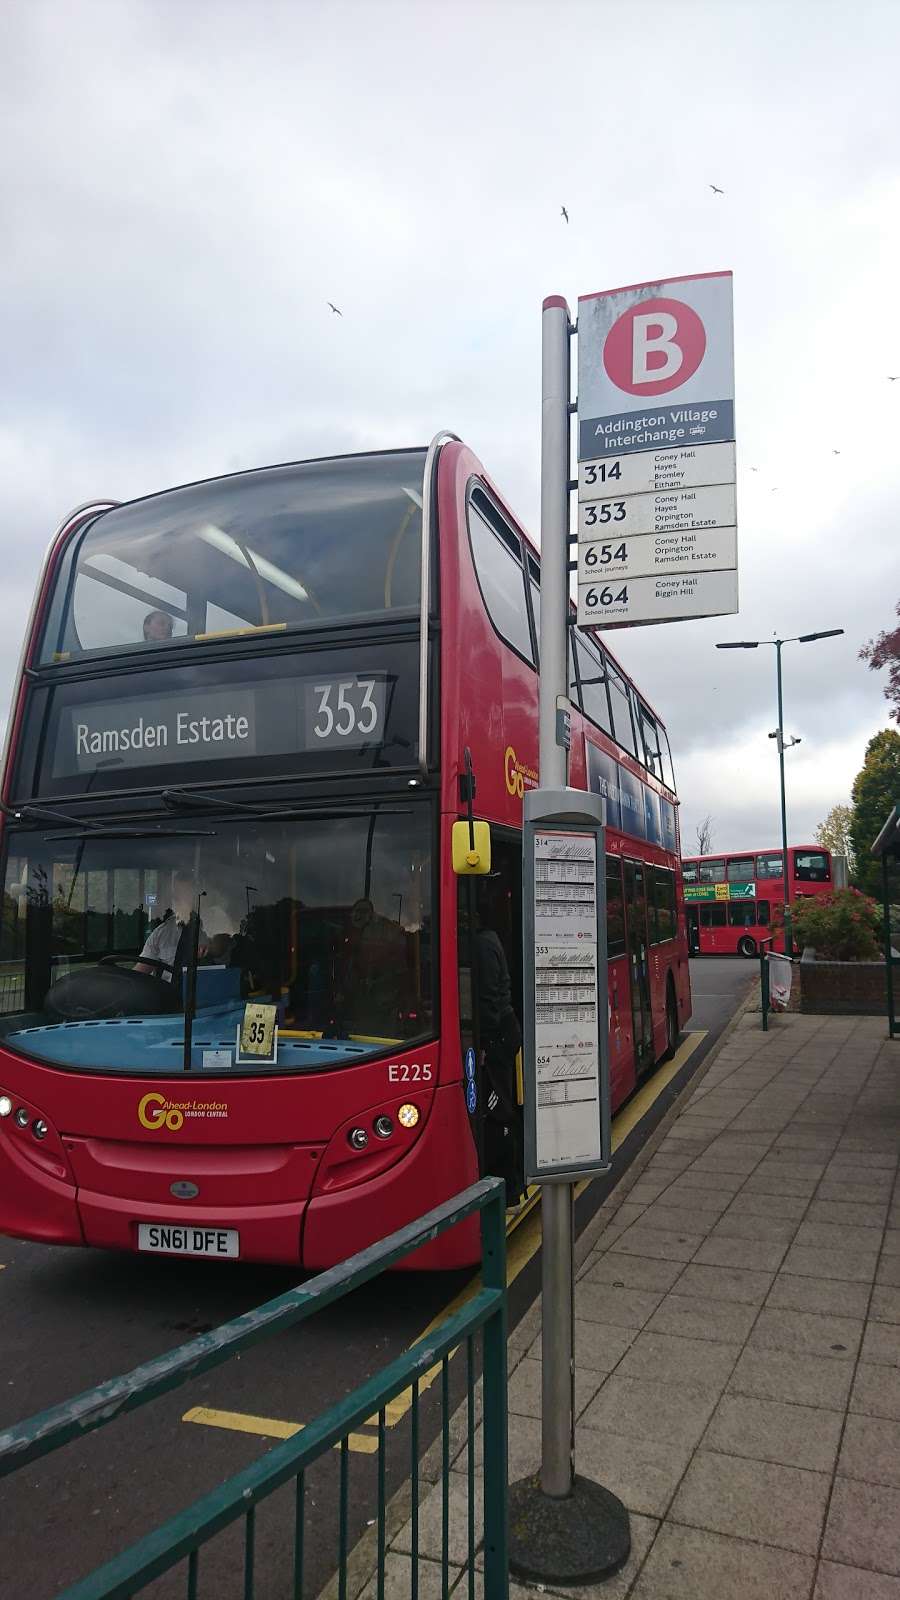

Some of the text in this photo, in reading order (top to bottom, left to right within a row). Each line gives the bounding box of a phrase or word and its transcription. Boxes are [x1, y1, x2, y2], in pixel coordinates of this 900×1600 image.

[632, 312, 684, 385] B
[594, 408, 718, 436] Addington Village
[604, 426, 686, 449] Interchange
[654, 451, 696, 462] Coney Hall
[584, 461, 622, 485] 314
[654, 463, 678, 471] Hayes
[654, 471, 686, 480] Bromley
[654, 481, 681, 489] Eltham
[654, 493, 697, 504] Coney Hall
[584, 501, 627, 526] 353
[654, 505, 678, 513] Hayes
[654, 512, 694, 522] Orpington
[654, 519, 717, 531] Ramsden Estate
[654, 537, 679, 545] Coney
[584, 543, 628, 567] 654
[654, 545, 694, 554] Orpington
[654, 552, 717, 564] Ramsden Estate
[655, 578, 698, 588] Coney Hall
[585, 584, 629, 607] 664
[655, 588, 694, 598] Biggin Hill
[313, 679, 378, 738] 353
[76, 712, 249, 755] Ramsden Estate
[504, 746, 525, 798] Go
[535, 838, 548, 847] 314
[535, 946, 549, 955] 353
[249, 1022, 266, 1044] 35
[536, 1055, 550, 1064] 654
[388, 1063, 432, 1082] E225
[137, 1092, 228, 1130] Go Ahead-London
[184, 1110, 228, 1118] LONDON CENTRAL
[149, 1227, 228, 1253] SN61 DFE
